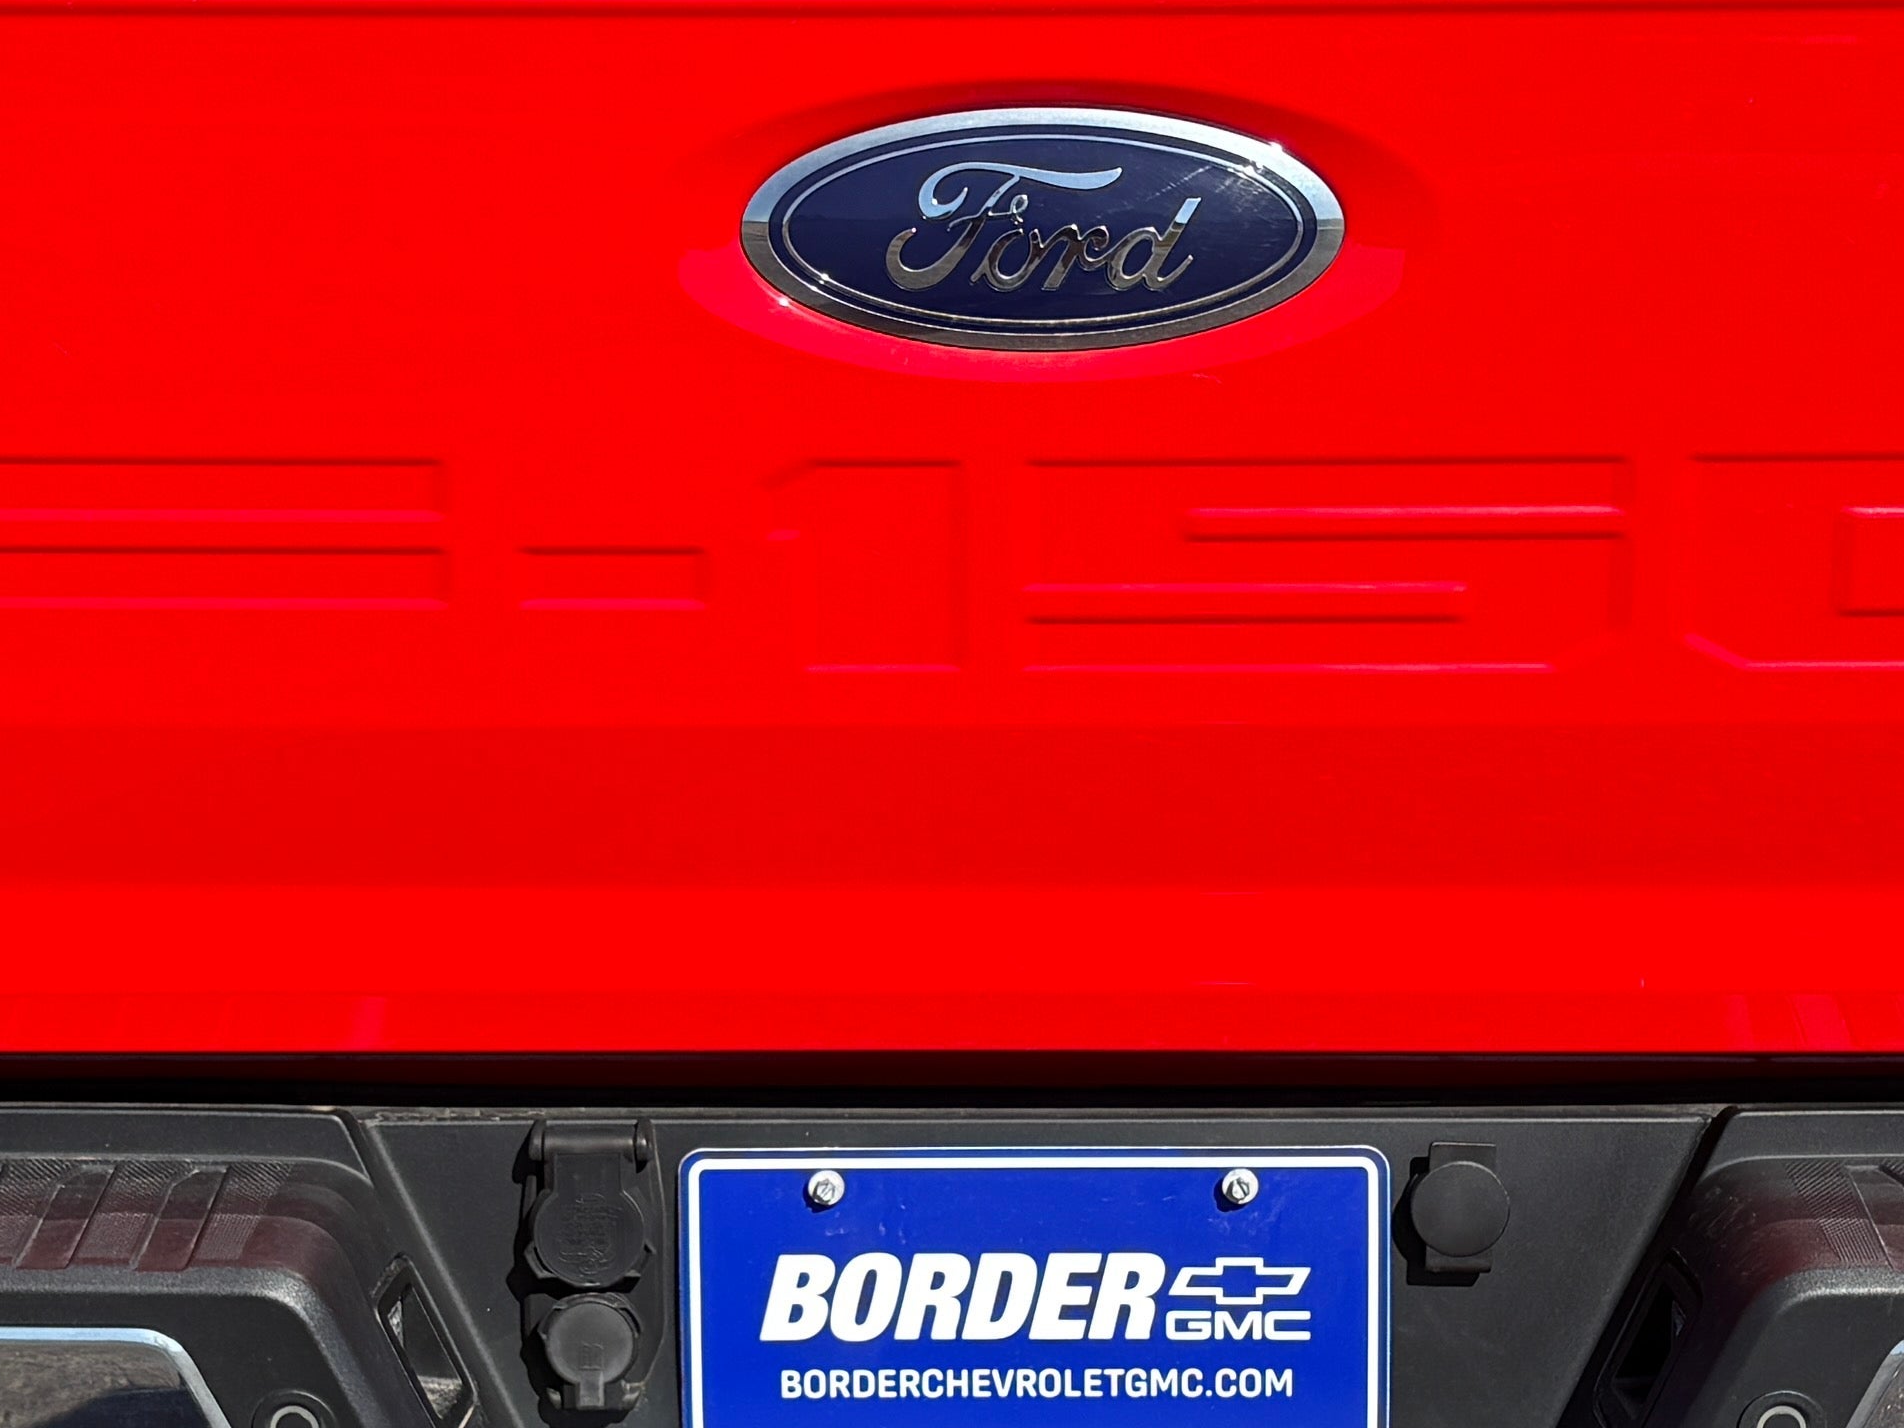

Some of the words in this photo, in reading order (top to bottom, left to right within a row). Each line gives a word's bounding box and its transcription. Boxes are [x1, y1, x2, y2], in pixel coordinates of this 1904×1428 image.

[886, 162, 1202, 292] Ford
[760, 1253, 1167, 1342] BORDER
[1166, 1310, 1312, 1341] GMC
[780, 1368, 1294, 1398] BORDERCHEVROLETGMC.COM
